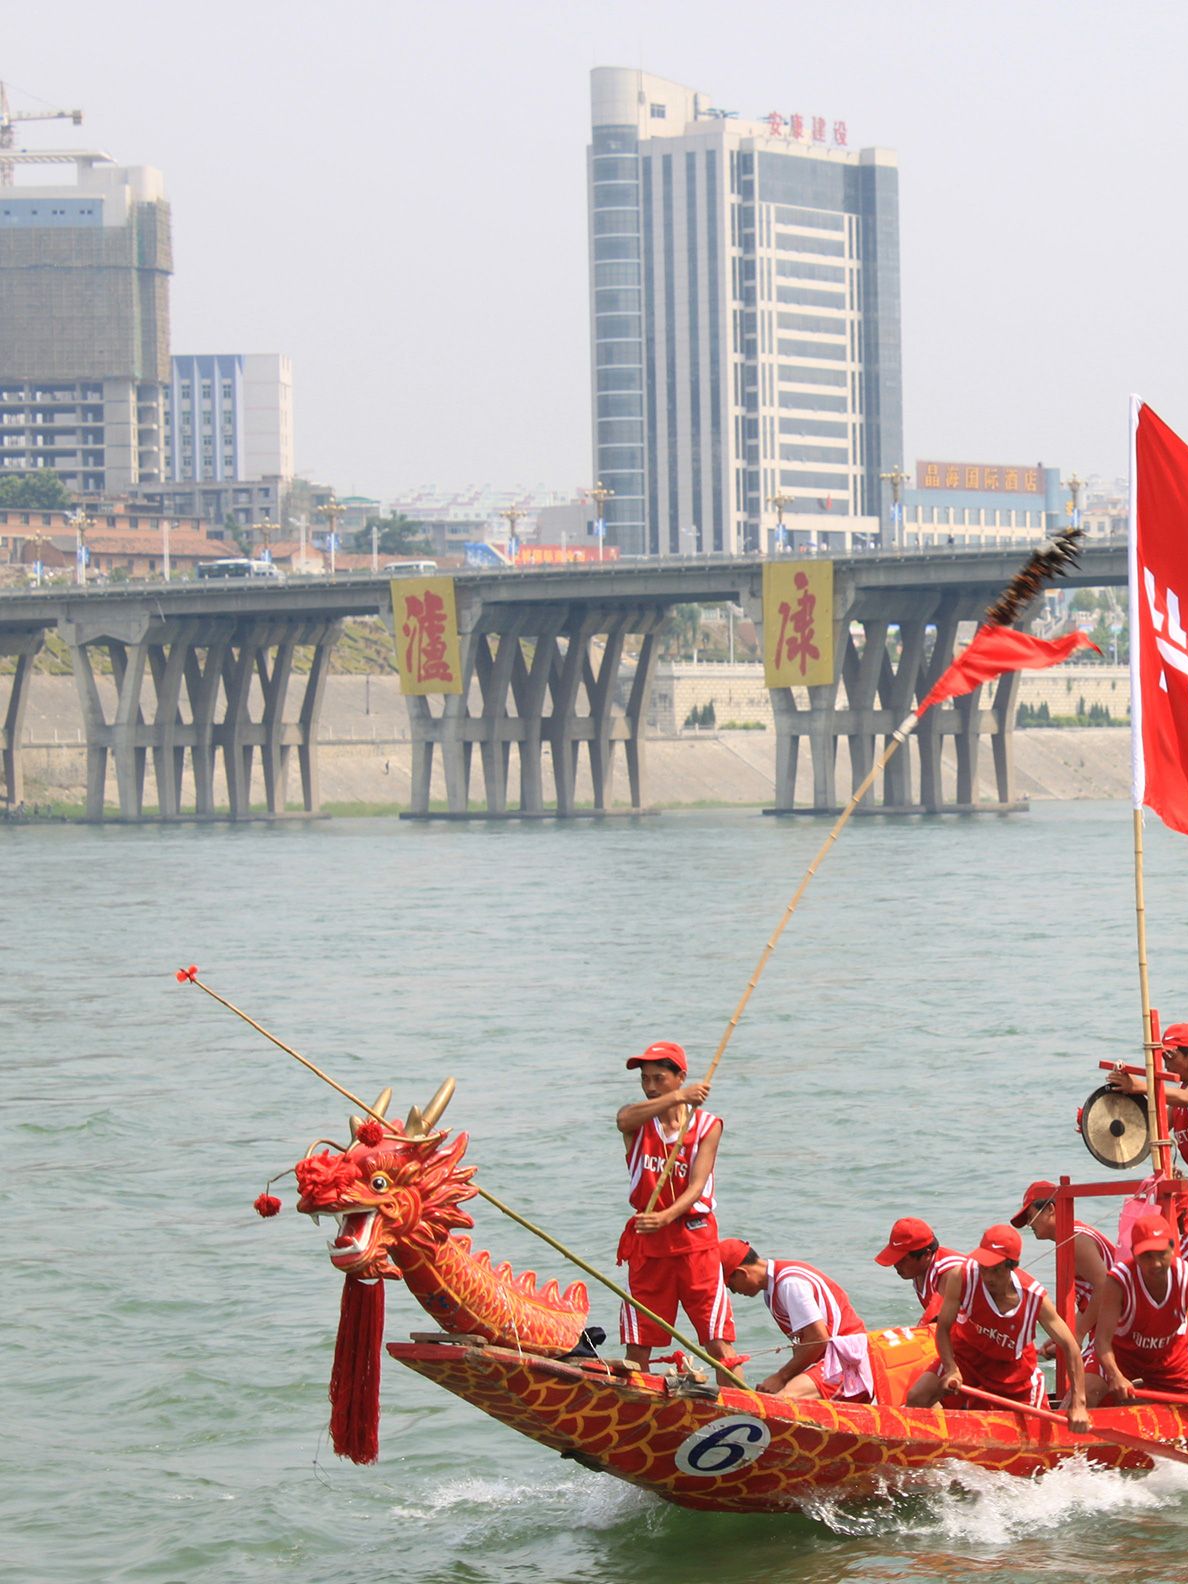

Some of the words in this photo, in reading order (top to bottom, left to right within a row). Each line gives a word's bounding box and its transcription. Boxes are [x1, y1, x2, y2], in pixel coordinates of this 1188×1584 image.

[768, 111, 848, 146] 安康建设
[924, 464, 1037, 492] 晶海国际酒店
[774, 571, 820, 676] 康
[643, 1154, 688, 1178] OCKTS
[687, 1423, 763, 1472] 6
